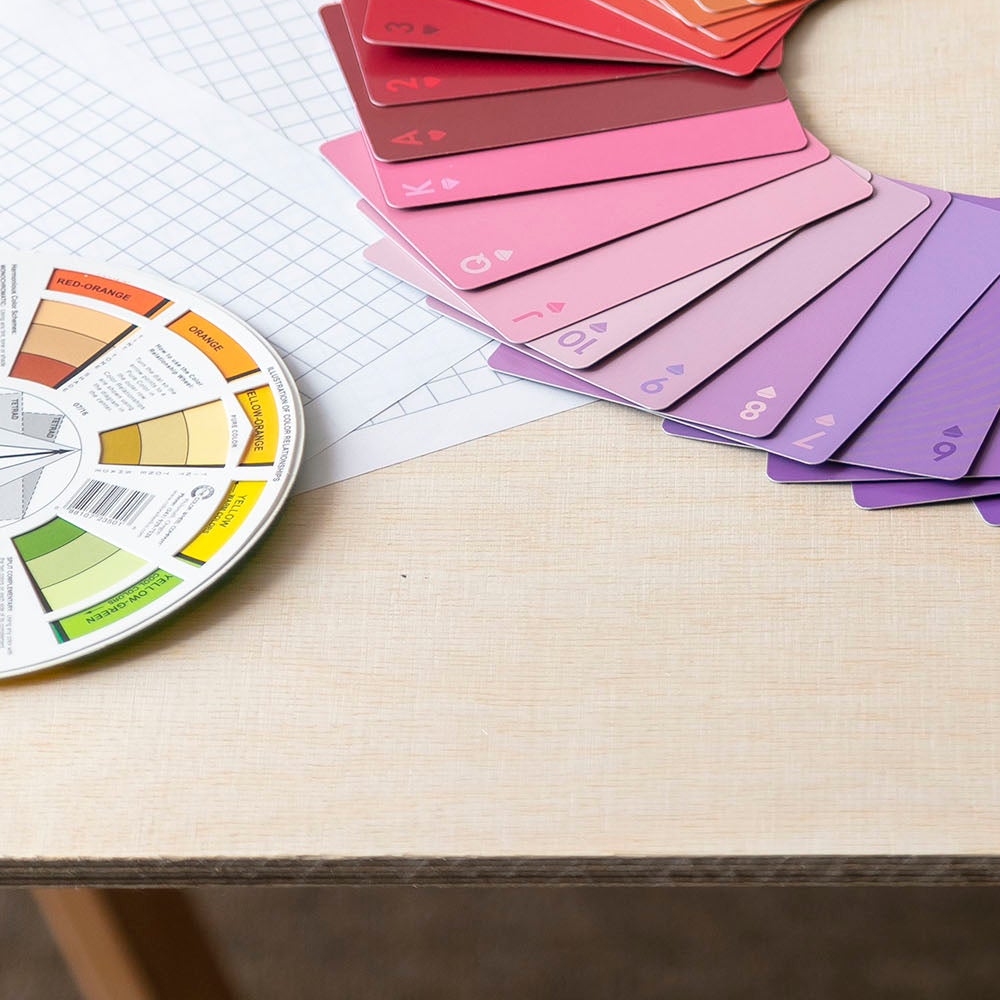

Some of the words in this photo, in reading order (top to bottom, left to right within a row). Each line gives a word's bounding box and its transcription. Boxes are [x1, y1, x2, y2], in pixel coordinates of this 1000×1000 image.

[385, 21, 413, 34] 3
[386, 77, 420, 93] 2
[391, 130, 424, 146] A
[402, 180, 435, 197] K
[460, 252, 492, 274] Q
[57, 278, 131, 301] RED-ORANGE
[512, 310, 544, 323] J
[188, 325, 224, 352] ORANGE
[557, 330, 597, 355] 10
[148, 347, 177, 375] Relationship
[155, 342, 166, 354] How
[188, 373, 203, 386] Color
[266, 366, 289, 404] ILLUSTRATION
[640, 377, 668, 394] 9
[11, 399, 19, 420] TETRAD
[740, 400, 767, 421] 8
[46, 417, 61, 438] TETRAD
[247, 390, 264, 452] ELLOW-ORANGE
[282, 413, 291, 435] COLOR
[231, 428, 239, 448] COLOR
[792, 431, 827, 450] 7
[271, 435, 291, 482] RELATIONSHIPS
[932, 441, 957, 462] 6
[219, 495, 248, 528] YELLOW
[202, 512, 223, 533] COLORS
[139, 572, 159, 586] COOL
[85, 574, 173, 625] YELLOW-GREEN
[107, 585, 139, 605] COLORS
